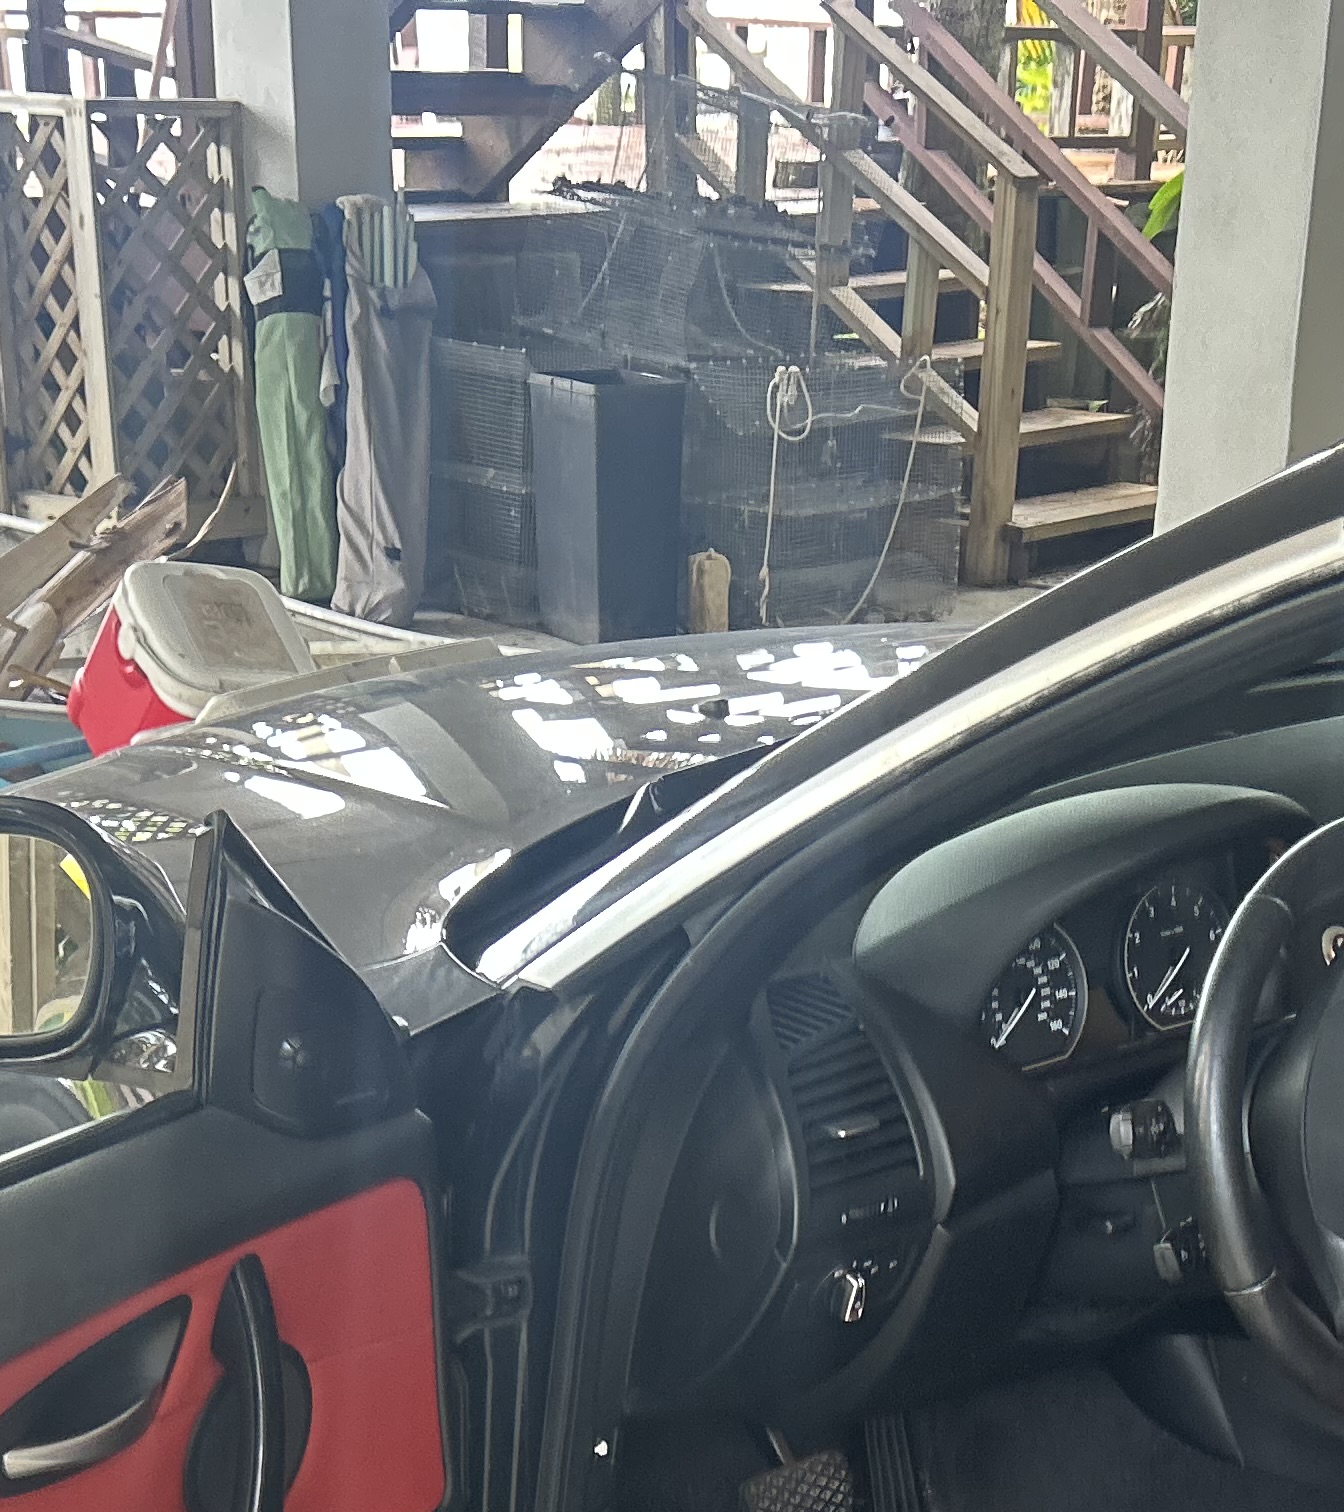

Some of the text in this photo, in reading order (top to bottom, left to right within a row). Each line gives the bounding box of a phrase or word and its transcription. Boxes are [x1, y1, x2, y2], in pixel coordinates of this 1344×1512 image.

[1134, 932, 1141, 944] 2
[1209, 930, 1216, 941] 6
[1055, 988, 1068, 1000] 140
